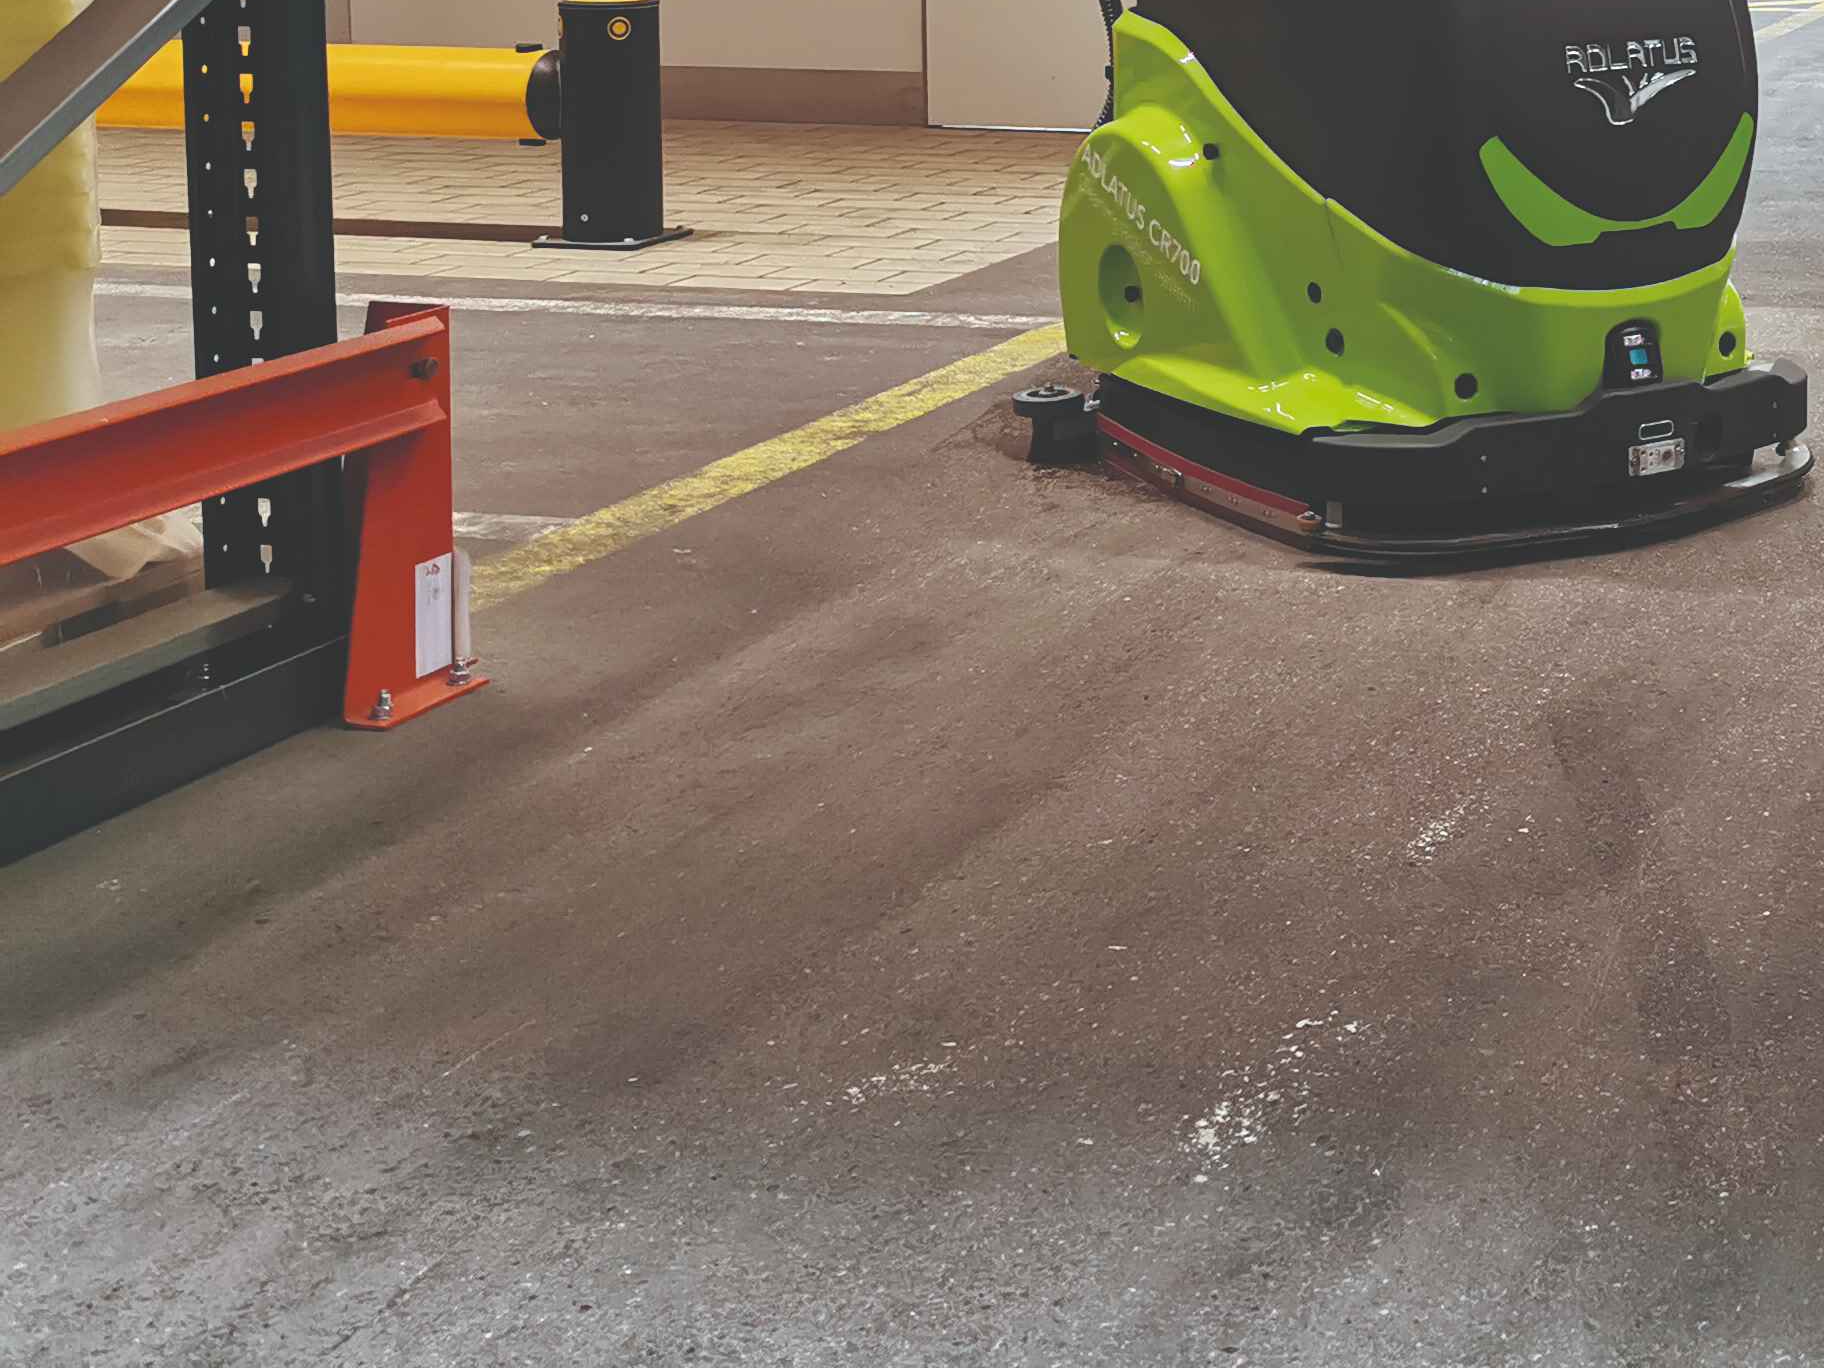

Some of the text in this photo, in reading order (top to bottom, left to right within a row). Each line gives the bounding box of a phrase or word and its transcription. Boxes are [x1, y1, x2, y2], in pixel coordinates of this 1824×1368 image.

[1564, 36, 1698, 73] ADLATUS
[1081, 143, 1147, 231] ADLATUS
[1149, 218, 1201, 285] CR700
